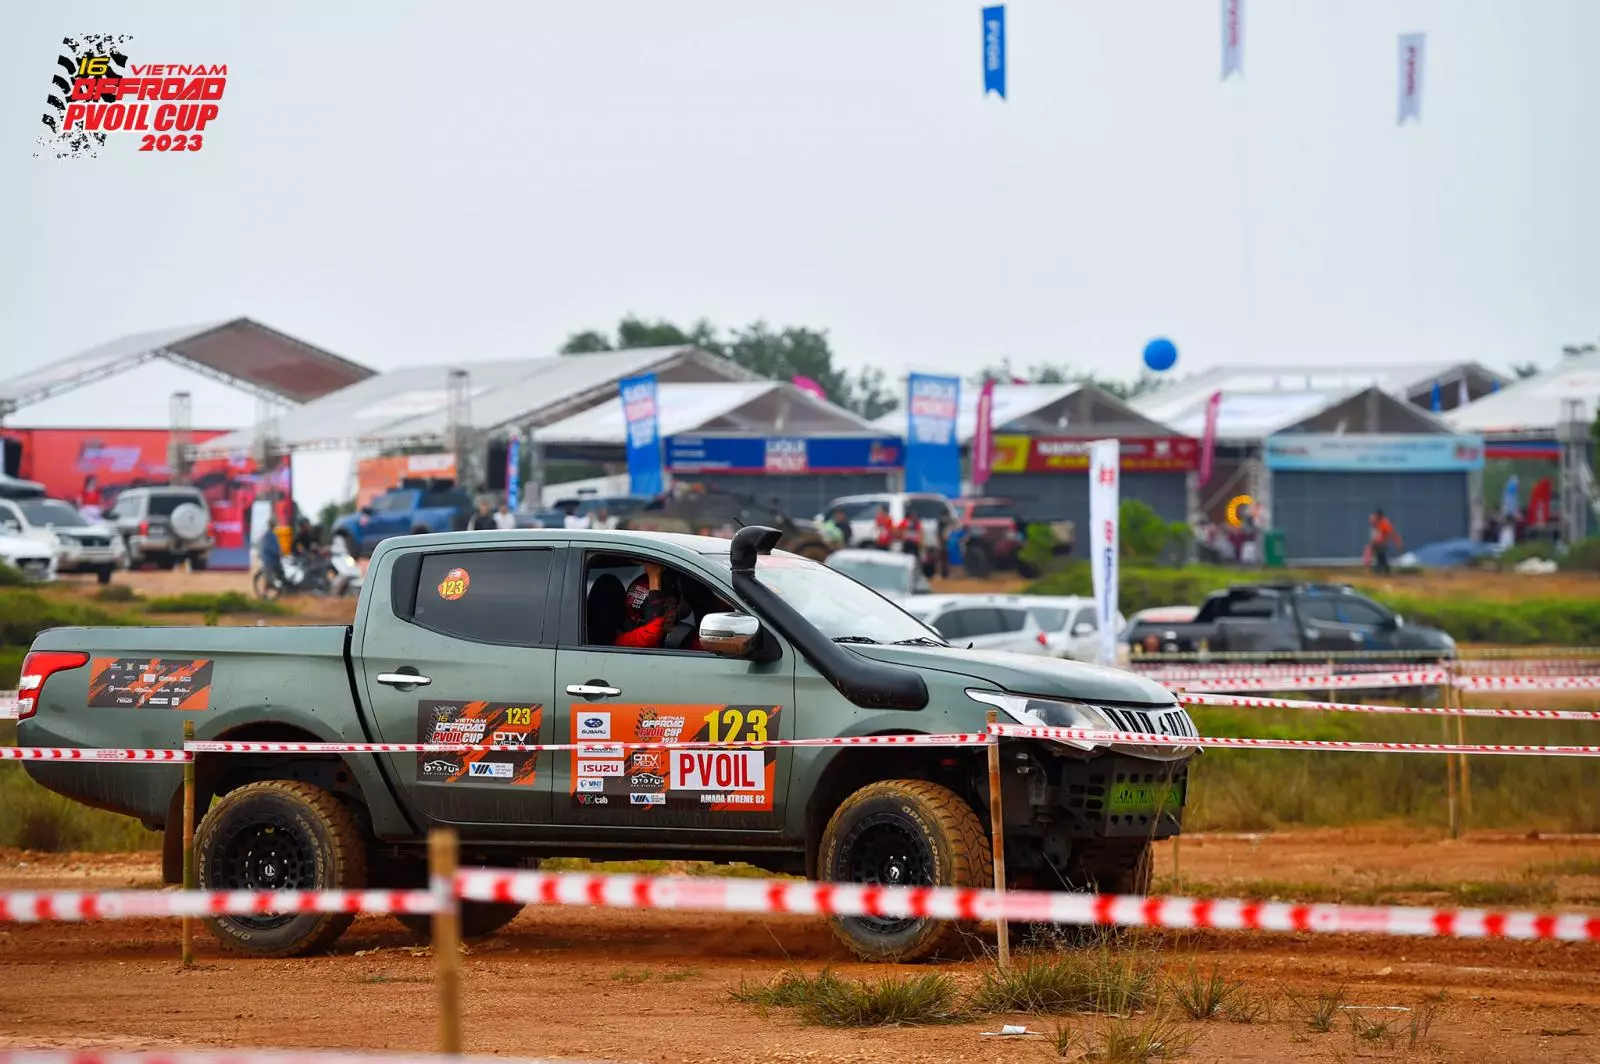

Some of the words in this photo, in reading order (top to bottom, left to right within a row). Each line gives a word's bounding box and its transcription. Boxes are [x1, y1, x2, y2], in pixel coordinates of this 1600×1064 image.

[442, 580, 464, 596] 123
[505, 707, 531, 725] 123
[435, 722, 486, 732] OFFROAD
[664, 728, 683, 737] CUP
[703, 709, 768, 750] 123
[432, 731, 461, 743] PVOIL
[462, 733, 484, 743] CUP
[583, 764, 619, 773] ISUZU
[679, 753, 756, 788] PVOIL
[902, 805, 931, 835] OPEN
